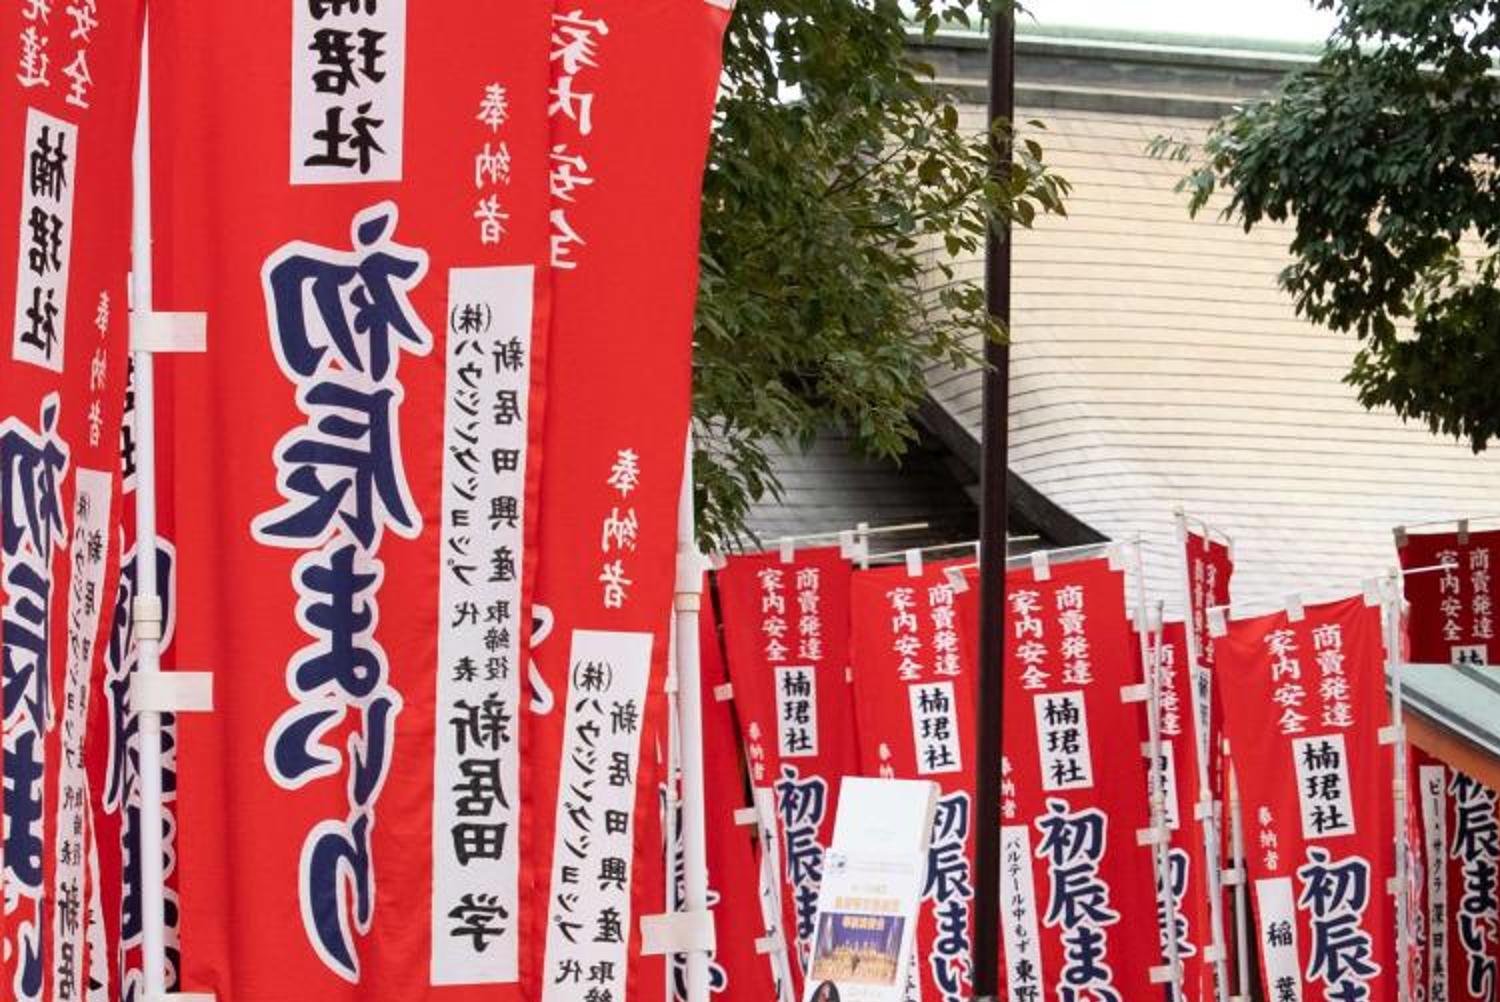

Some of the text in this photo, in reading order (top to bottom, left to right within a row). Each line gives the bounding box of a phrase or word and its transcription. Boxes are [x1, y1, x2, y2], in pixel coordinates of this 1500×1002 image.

[757, 567, 790, 662] 家内安全
[886, 586, 924, 681] 家内安全
[1007, 589, 1053, 691] 家内安全
[1054, 584, 1094, 686] 商賣発達
[782, 671, 815, 753] 楠珺社
[1263, 628, 1309, 735] 家内安全
[1311, 622, 1353, 729] 商賣発達
[917, 687, 956, 770] 楠珺社
[1043, 697, 1090, 786] 楠珺社
[1303, 739, 1349, 834] 楠珺社
